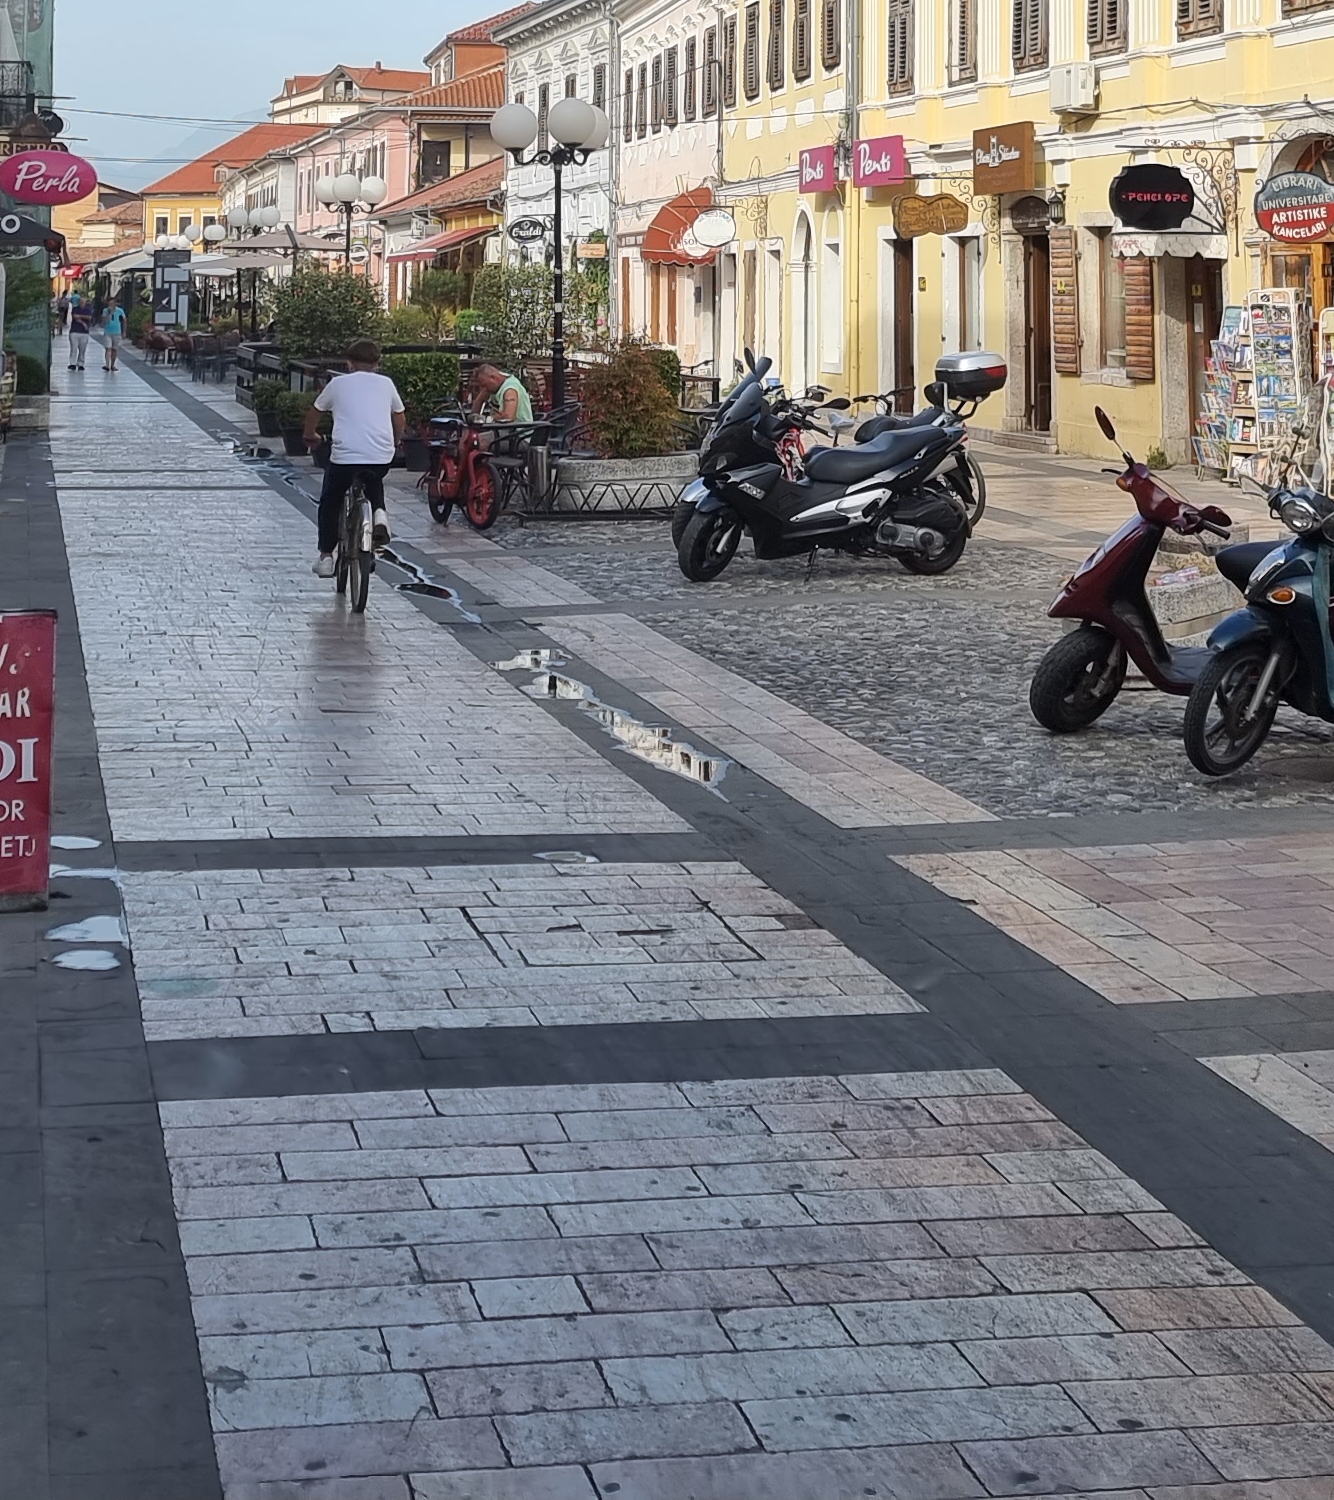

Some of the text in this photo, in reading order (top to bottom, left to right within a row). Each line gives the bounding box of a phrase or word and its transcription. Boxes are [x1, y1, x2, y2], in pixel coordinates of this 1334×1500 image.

[800, 152, 824, 186] Penti
[857, 143, 892, 180] Penti
[14, 160, 80, 194] Perla
[1261, 193, 1332, 211] UNIVERSITARE
[1271, 206, 1328, 225] ARTISTIKE
[1272, 220, 1327, 239] KANCELARI
[0, 835, 37, 859] ETJ
